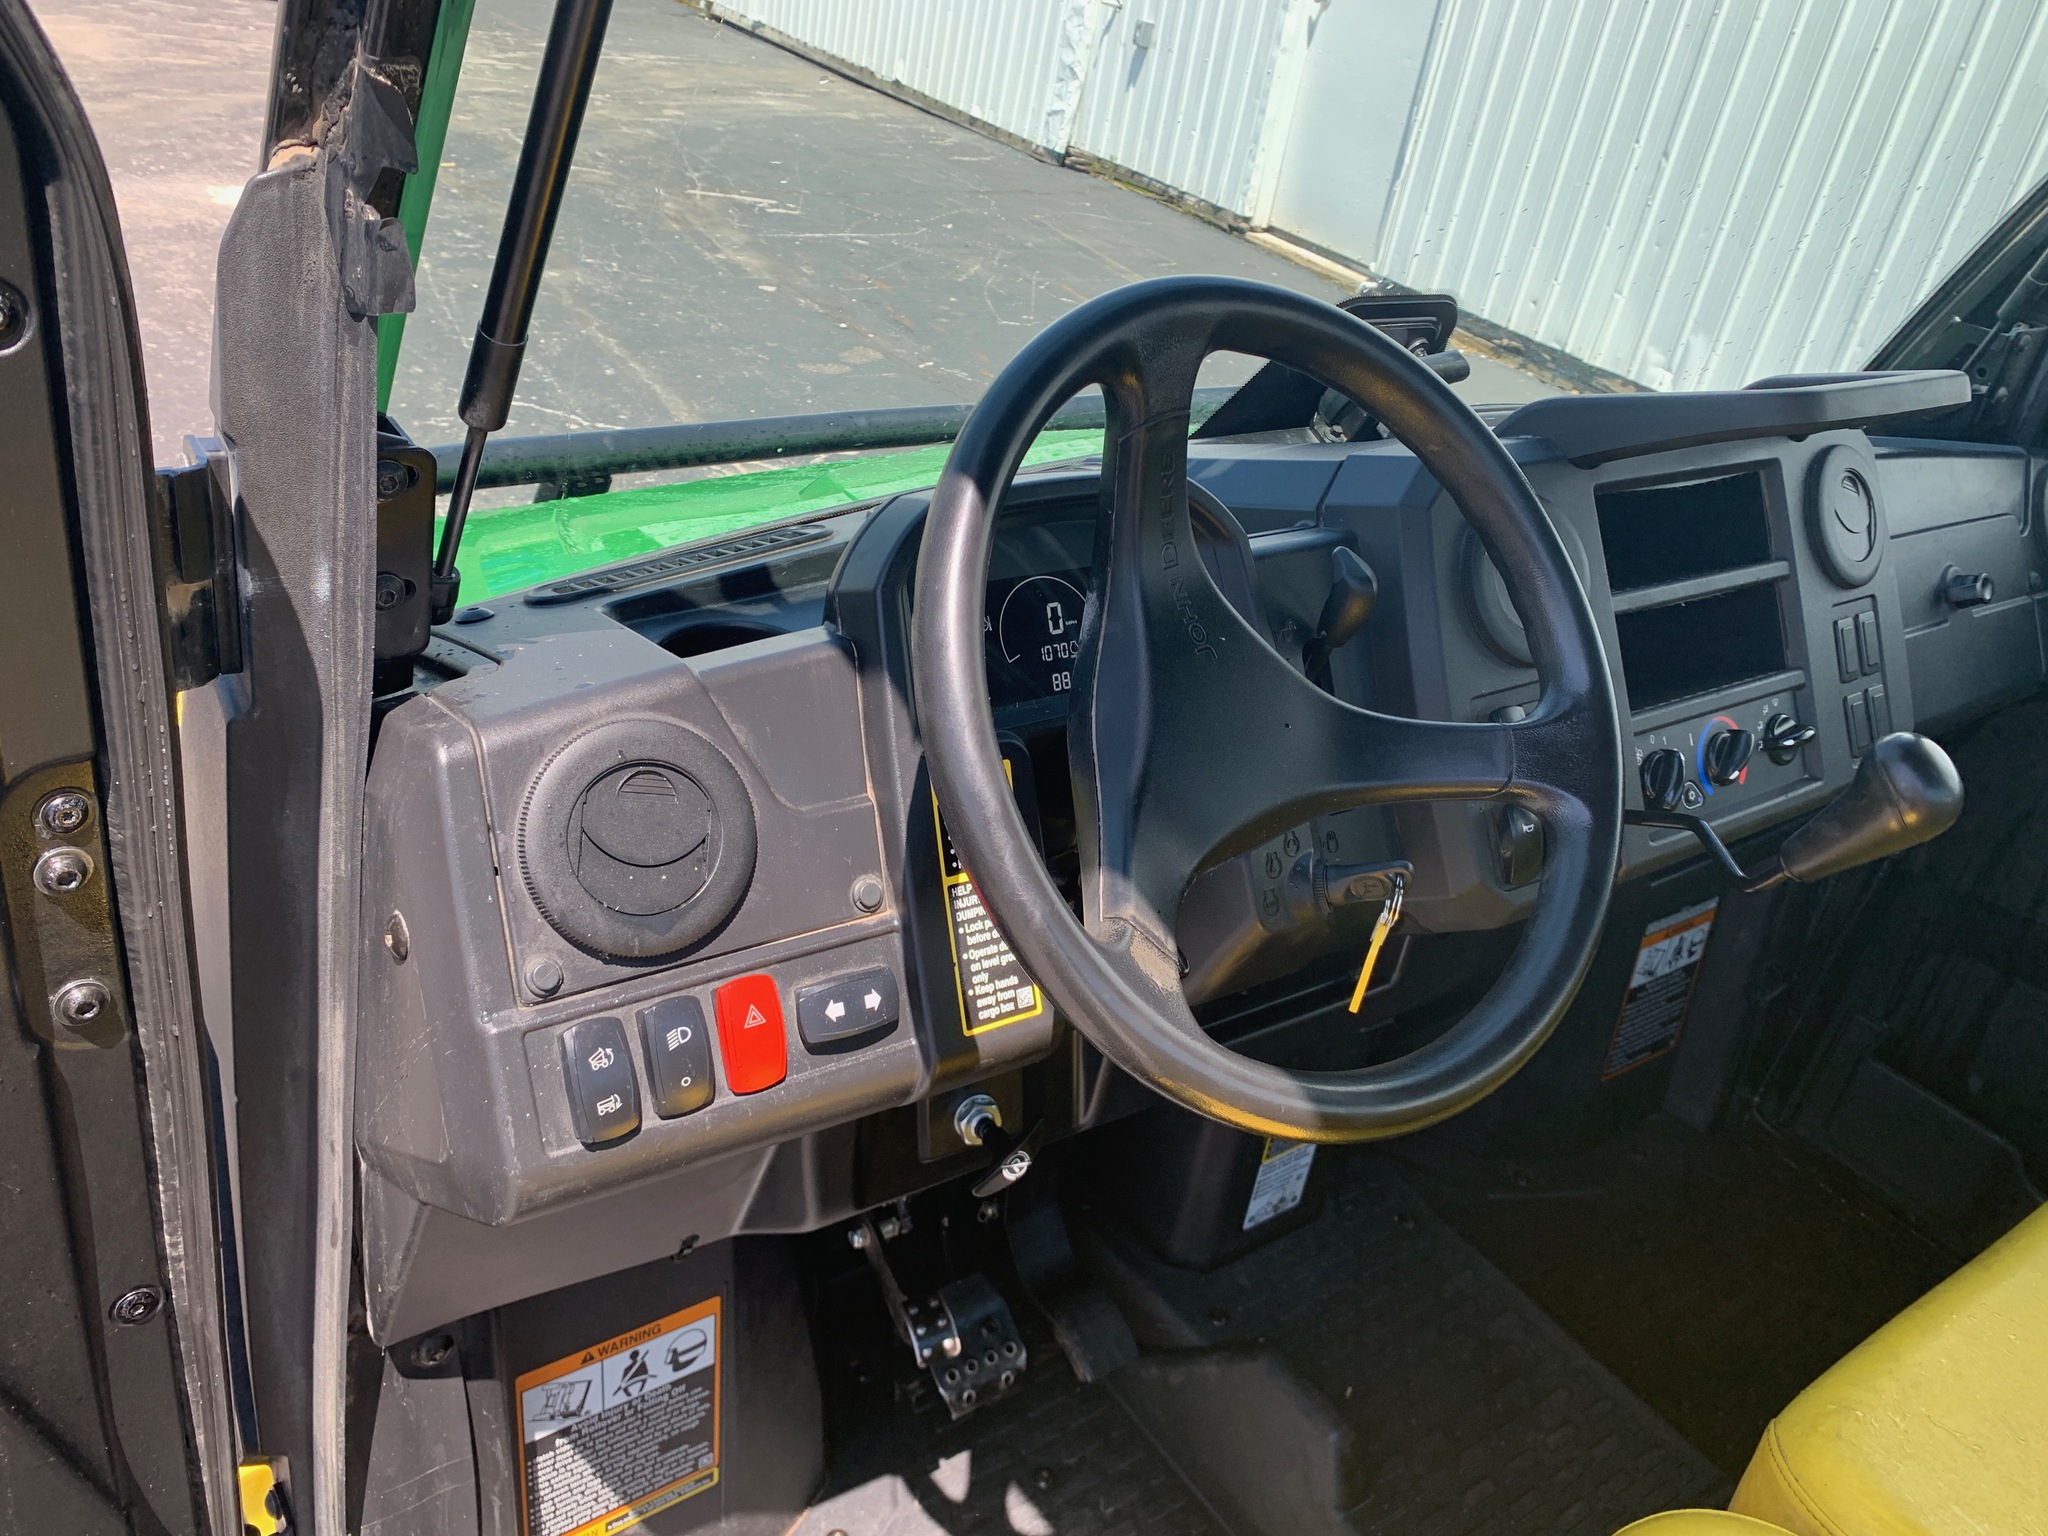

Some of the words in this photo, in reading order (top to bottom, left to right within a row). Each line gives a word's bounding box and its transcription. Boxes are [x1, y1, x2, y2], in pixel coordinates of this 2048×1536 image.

[1046, 601, 1065, 635] 0
[1169, 575, 1218, 662] JOHN
[1052, 671, 1071, 691] 88
[951, 883, 973, 897] HELP
[953, 894, 981, 909] INJUR
[956, 905, 987, 922] DUMPIN
[964, 920, 984, 934] Lock
[966, 931, 991, 946] before
[968, 944, 998, 960] Operate
[970, 962, 981, 972] on
[981, 955, 1000, 969] level
[972, 971, 989, 984] only
[974, 983, 995, 996] Keep
[995, 975, 1019, 990] hands
[976, 995, 996, 1008] away
[997, 989, 1015, 1001] from
[978, 1006, 1000, 1020] cargo
[1000, 1001, 1015, 1013] box
[597, 1323, 662, 1357] WARNING
